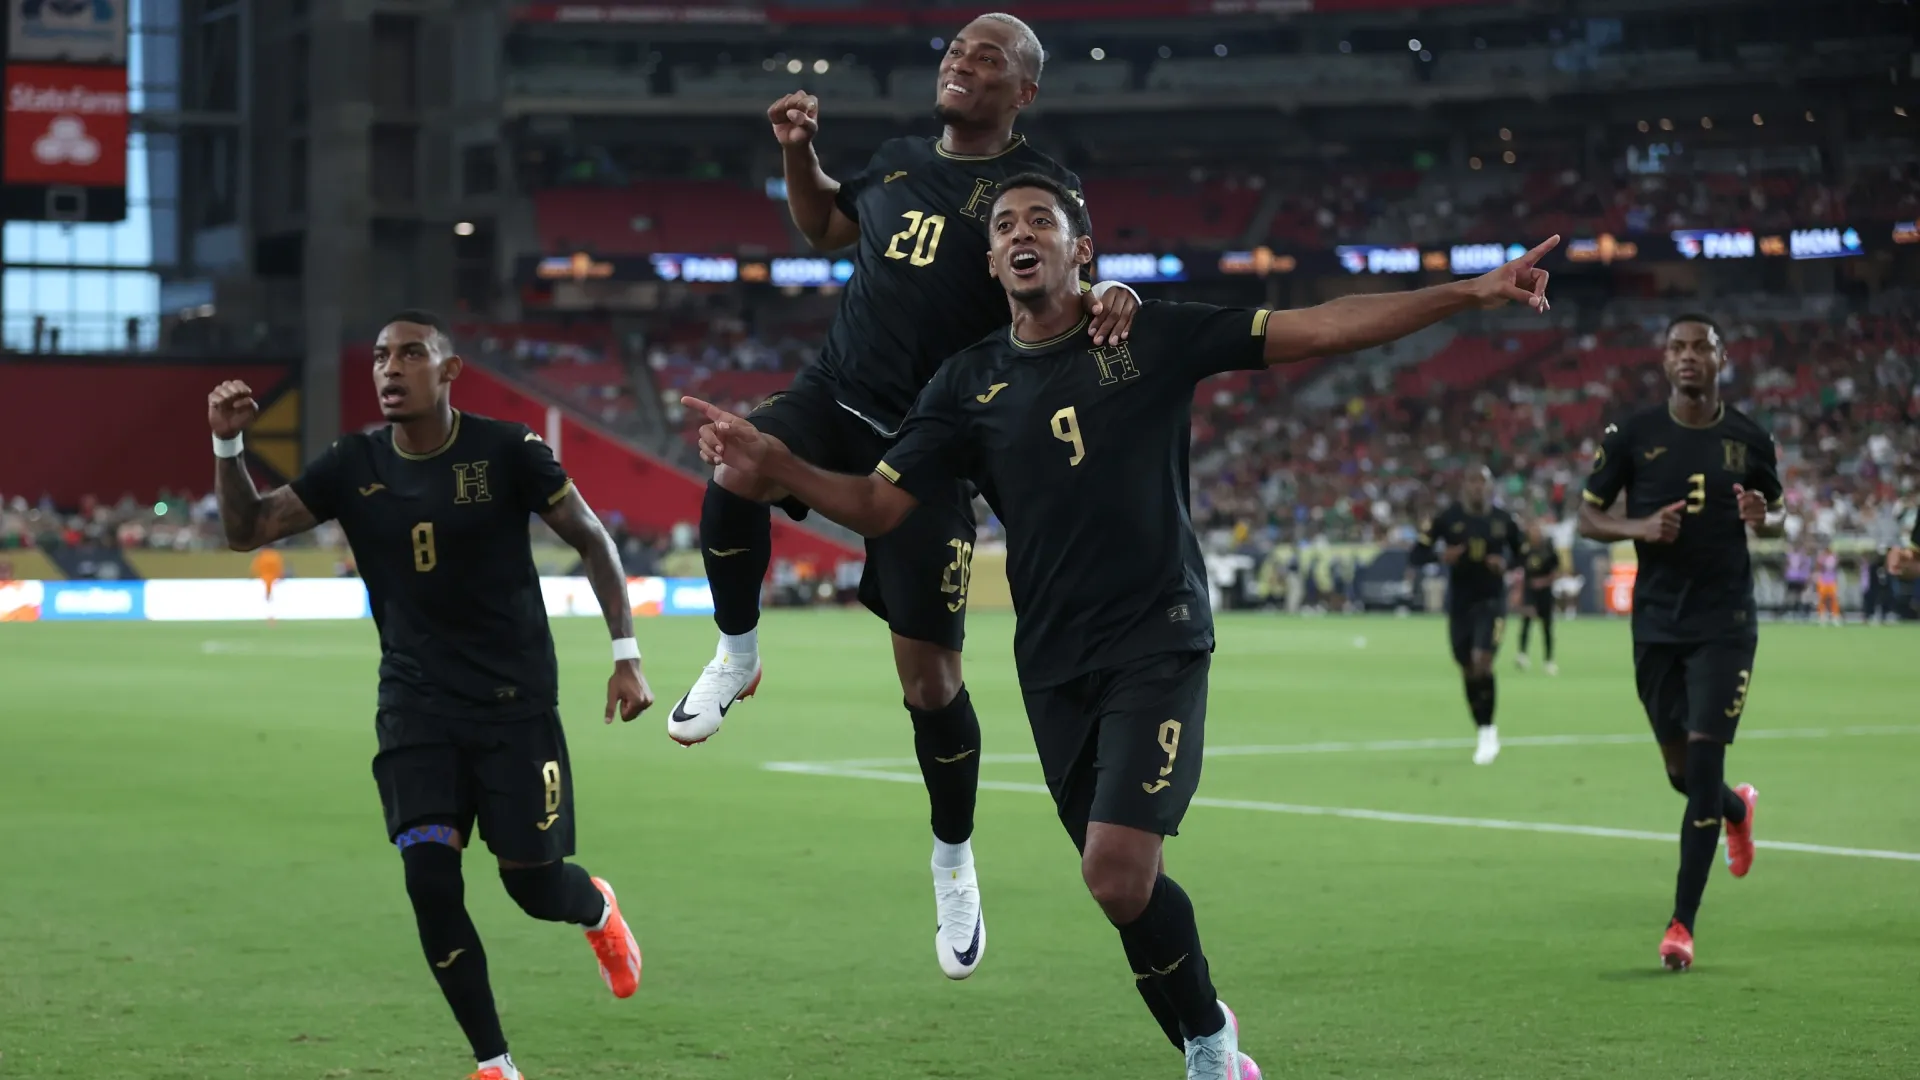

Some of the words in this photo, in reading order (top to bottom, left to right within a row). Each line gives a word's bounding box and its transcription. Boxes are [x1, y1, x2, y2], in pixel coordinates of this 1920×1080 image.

[885, 210, 945, 267] 20
[1703, 231, 1755, 259] PAN
[1088, 341, 1140, 386] H
[1051, 407, 1085, 466] 9
[452, 460, 492, 504] H
[1686, 473, 1706, 513] 3
[412, 522, 436, 572] 8
[1158, 719, 1182, 777] 9
[542, 760, 562, 813] 8
